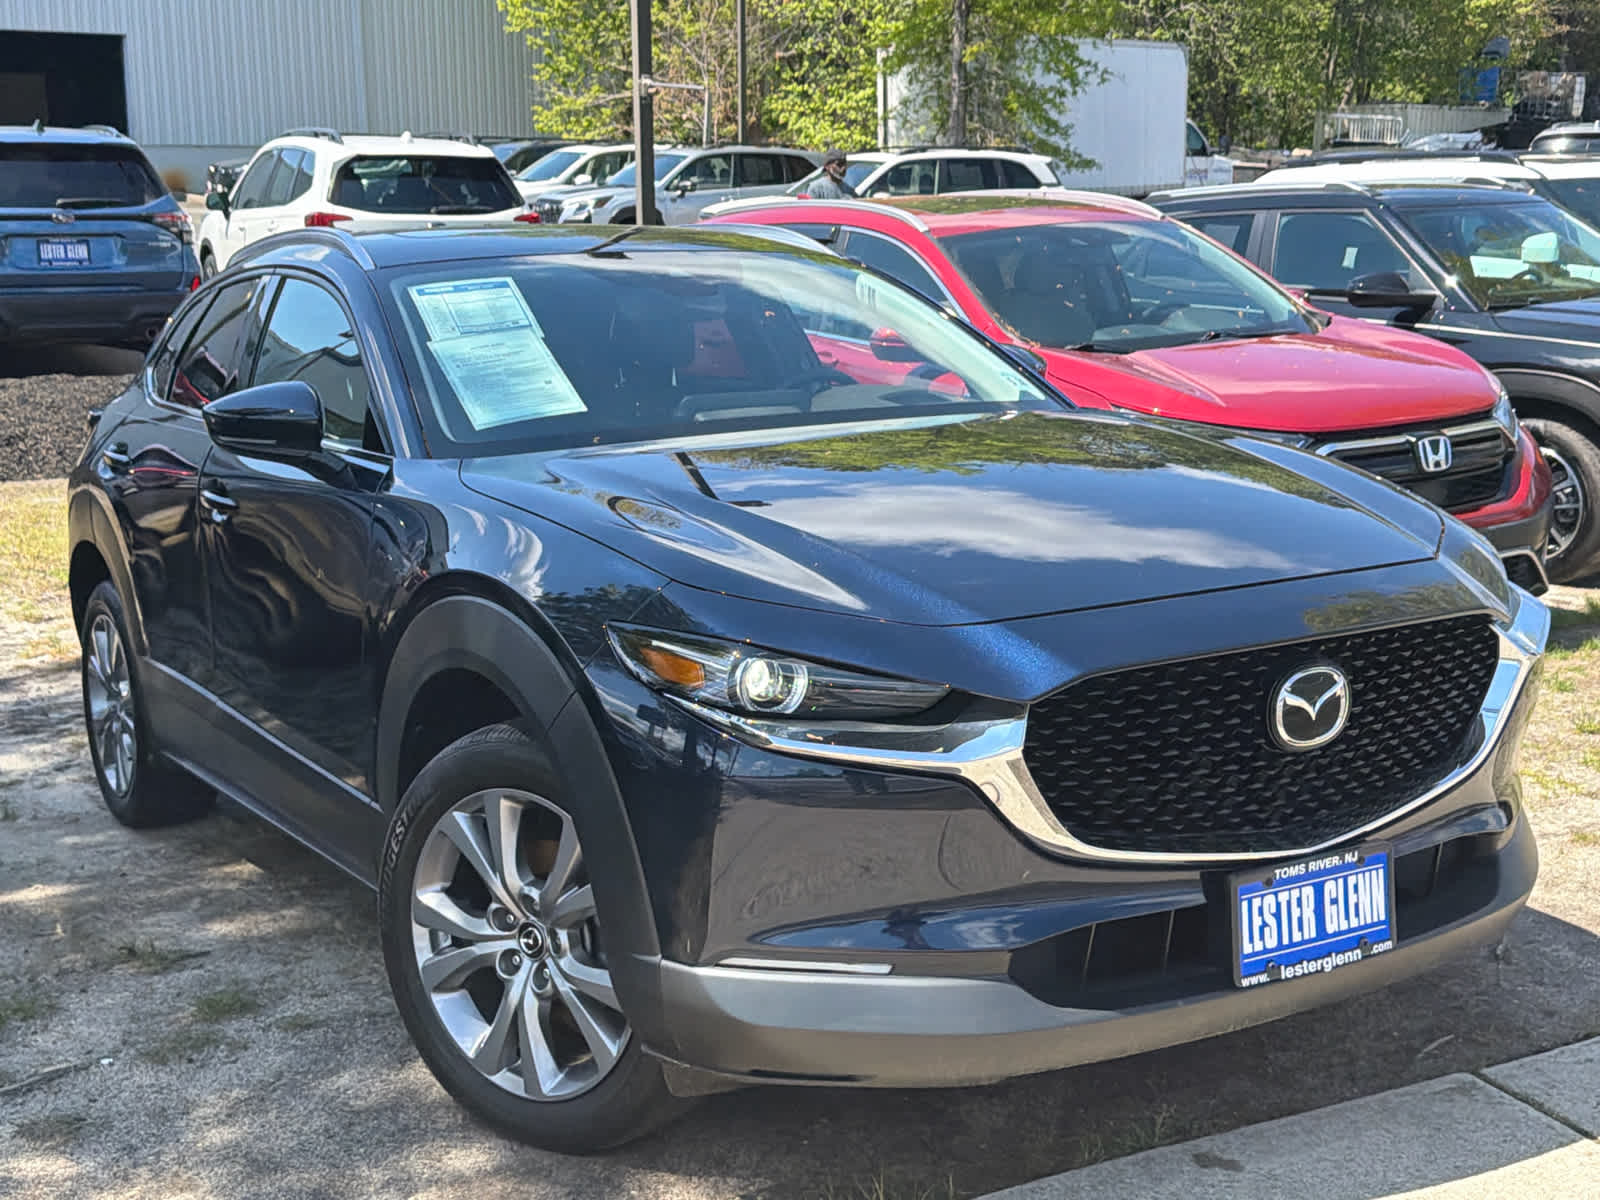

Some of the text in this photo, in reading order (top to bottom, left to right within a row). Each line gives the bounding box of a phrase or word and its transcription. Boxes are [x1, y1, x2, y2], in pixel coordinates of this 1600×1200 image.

[40, 243, 65, 259] LESTER
[1274, 865, 1306, 881] TOMS
[1344, 850, 1359, 865] NJ
[1241, 868, 1386, 955] LESTER GLENN
[1280, 949, 1362, 980] lesterglenn
